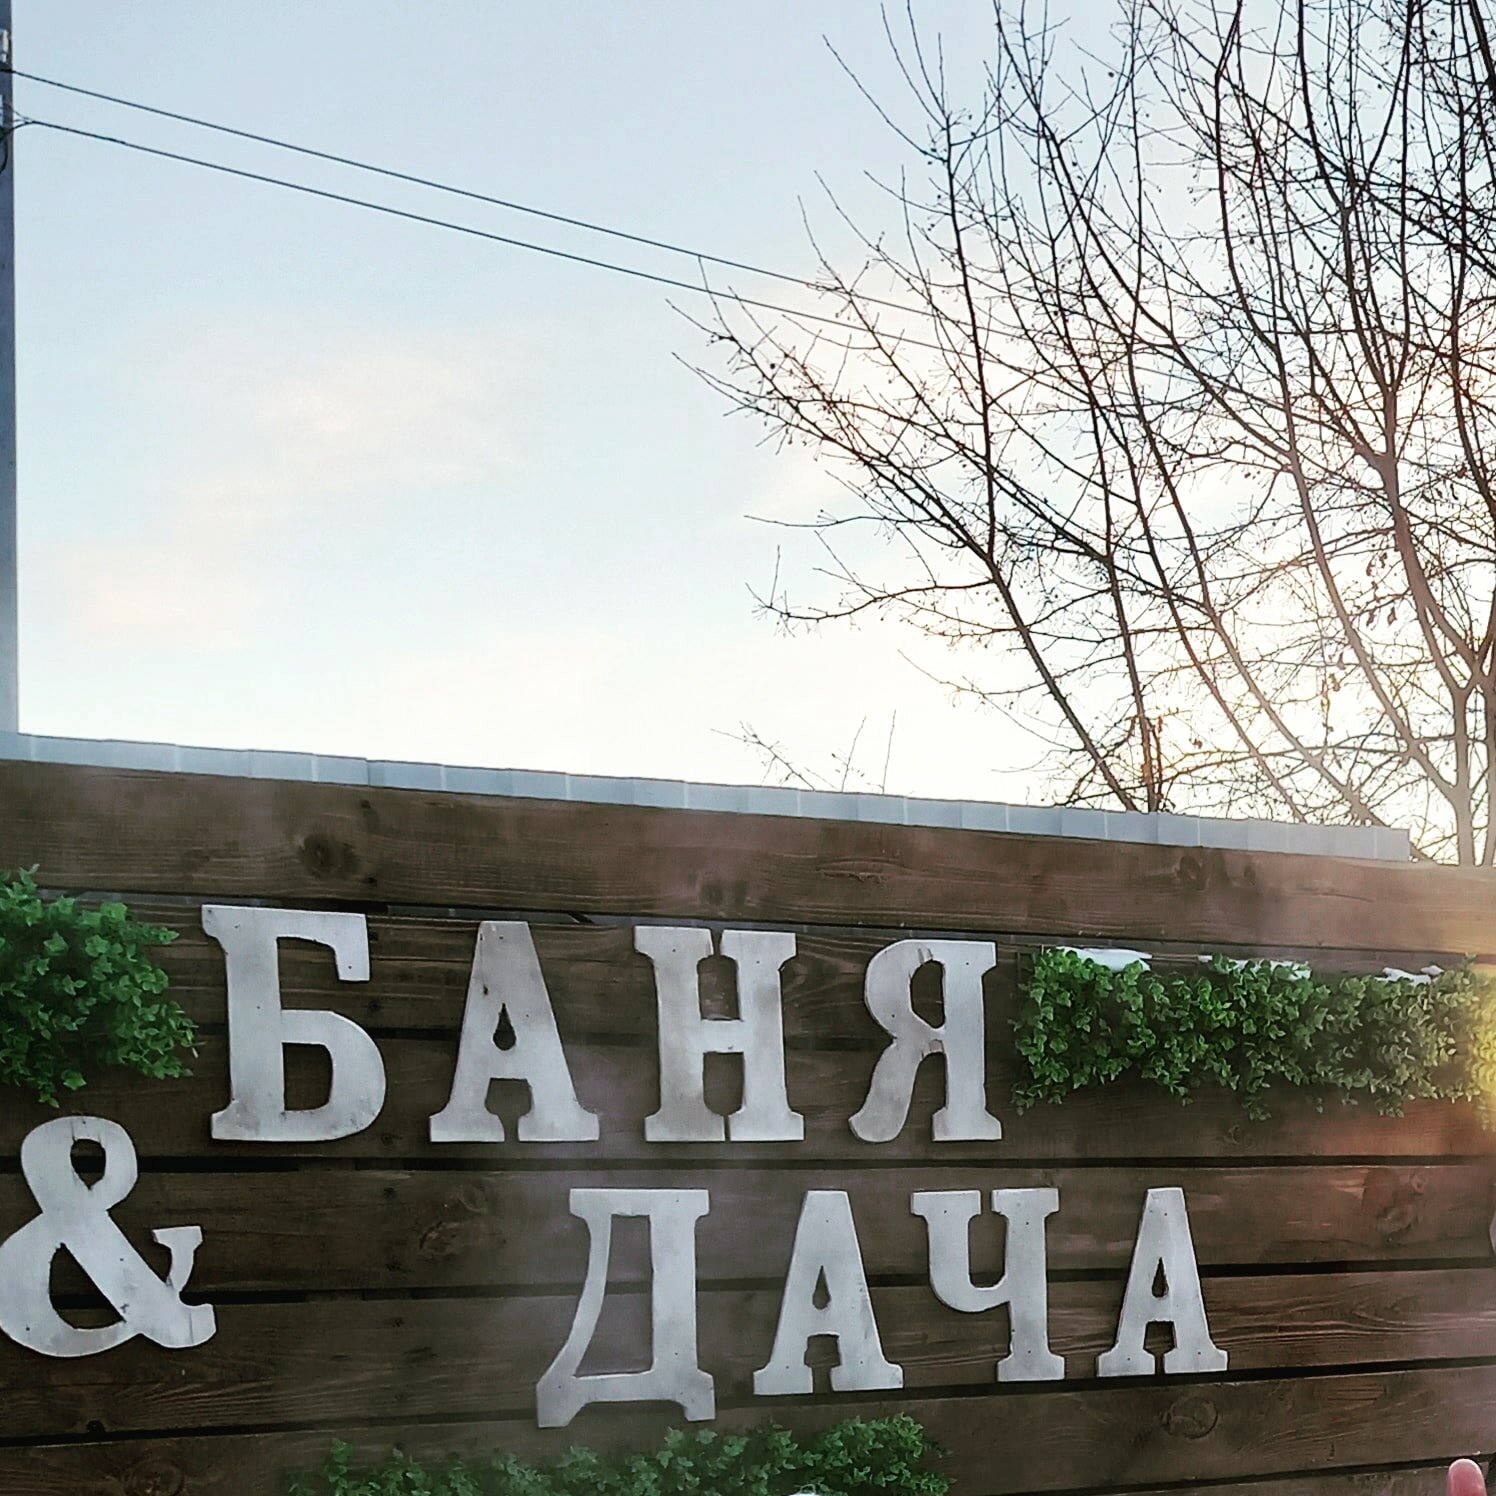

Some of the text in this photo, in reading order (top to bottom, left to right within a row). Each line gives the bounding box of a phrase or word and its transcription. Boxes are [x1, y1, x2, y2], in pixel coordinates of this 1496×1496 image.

[202, 904, 1002, 1143] БАНЯ
[0, 1116, 1229, 1428] & ДАЧА
